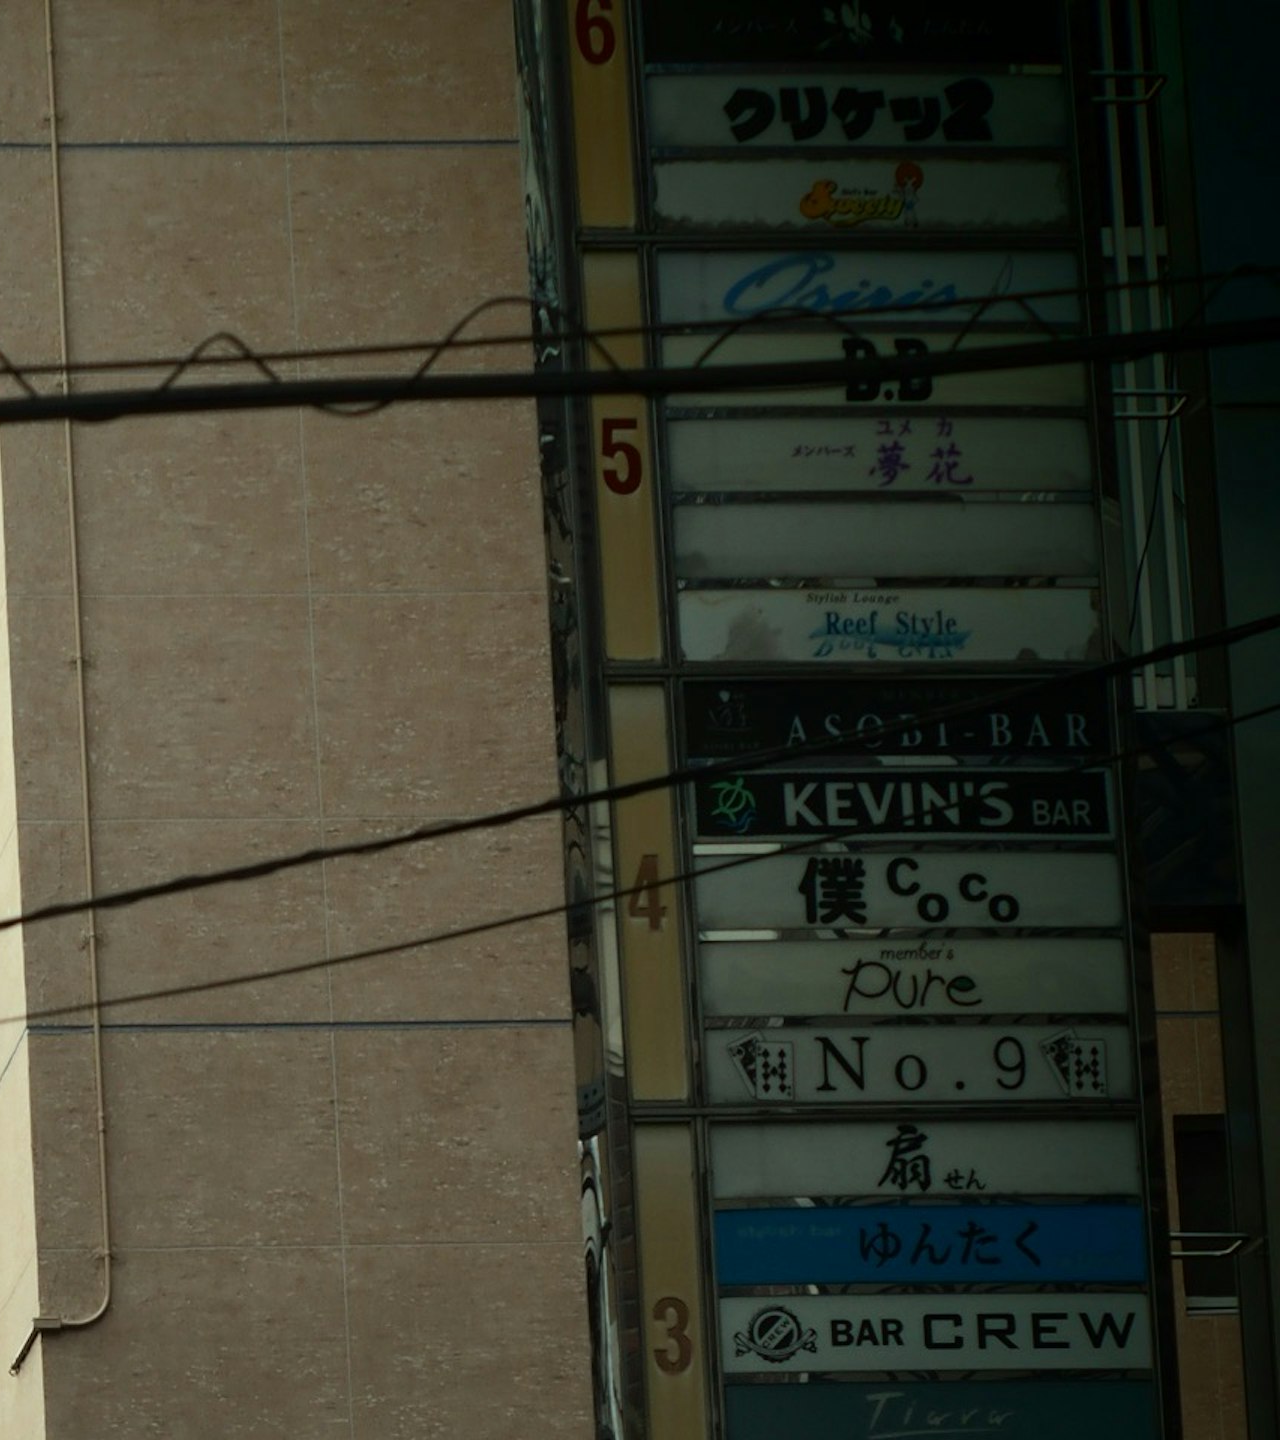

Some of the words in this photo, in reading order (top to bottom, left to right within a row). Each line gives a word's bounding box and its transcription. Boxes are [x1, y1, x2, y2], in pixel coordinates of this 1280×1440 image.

[575, 0, 617, 64] 6
[723, 251, 956, 316] Osiris
[601, 418, 641, 495] 5
[825, 611, 878, 636] Reef
[896, 610, 958, 640] Style
[783, 780, 1016, 828] KEVIN'S
[1031, 799, 1093, 828] BAR
[627, 852, 667, 931] 4
[798, 857, 867, 924] 僕
[880, 943, 954, 962] member's
[878, 1124, 932, 1192] 扇
[943, 1169, 987, 1191] せん
[858, 1221, 1042, 1269] ゆんたく
[651, 1296, 693, 1375] 3
[830, 1318, 905, 1347] BAR
[923, 1312, 1135, 1350] CREW
